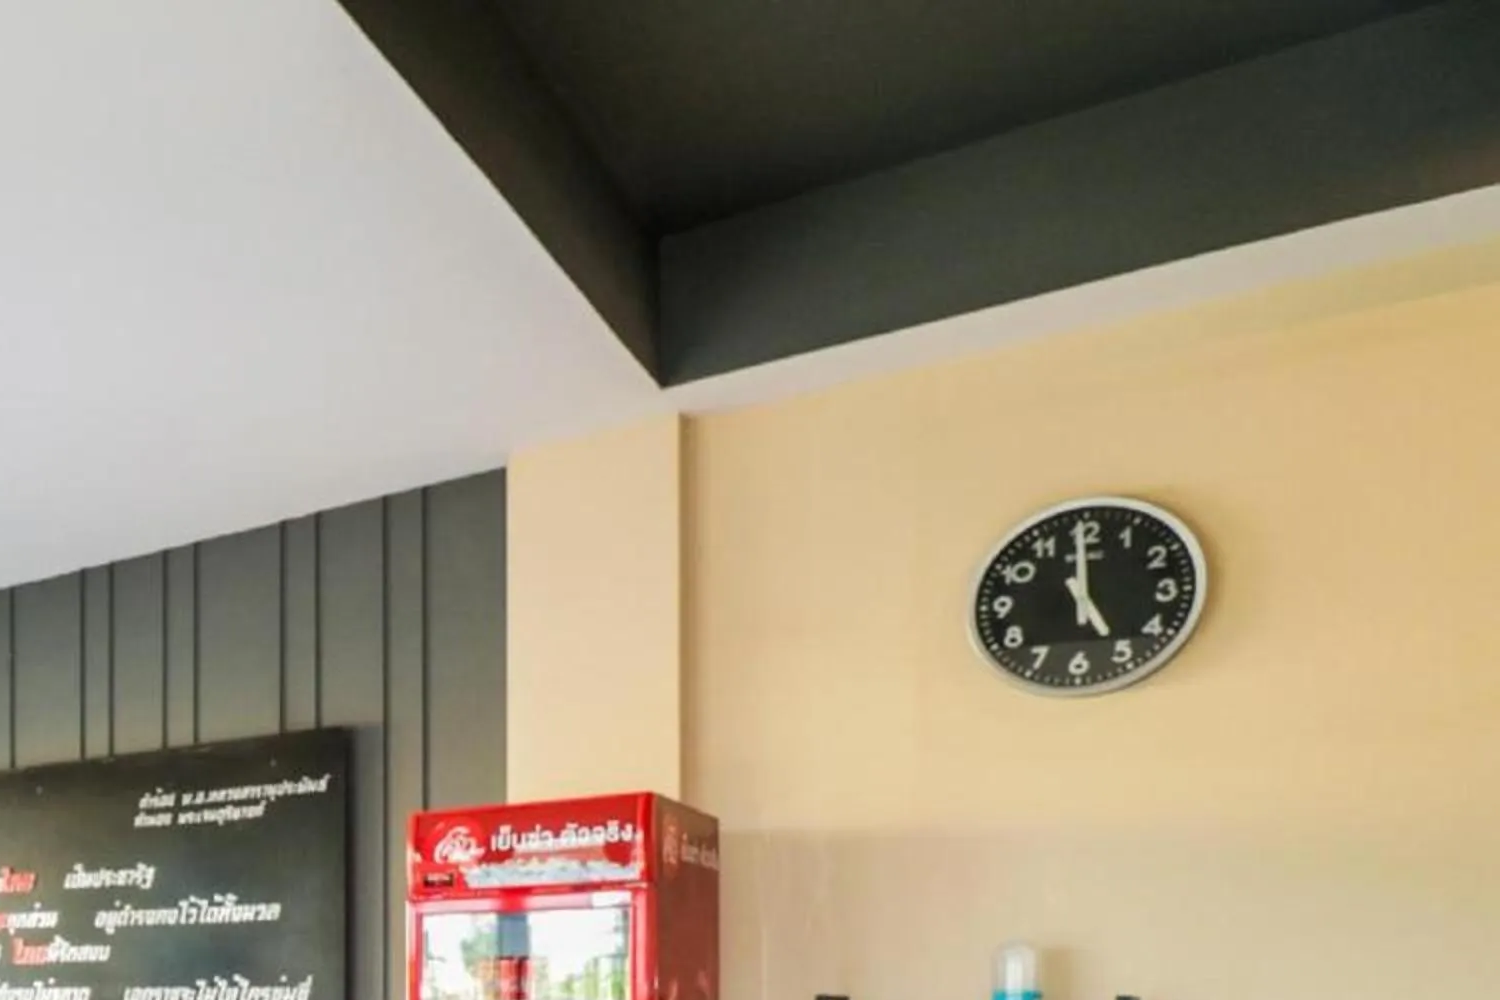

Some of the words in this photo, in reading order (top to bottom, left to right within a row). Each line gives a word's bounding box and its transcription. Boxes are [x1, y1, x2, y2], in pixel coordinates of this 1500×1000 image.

[1032, 537, 1056, 558] 11
[1118, 526, 1132, 549] 1
[1147, 545, 1167, 569] 2
[1002, 561, 1036, 584] 10
[1155, 578, 1178, 602] 3
[992, 595, 1013, 618] 9
[1003, 625, 1023, 648] 8
[1141, 614, 1163, 636] 4
[1030, 645, 1050, 669] 7
[1111, 639, 1132, 663] 5
[1068, 652, 1089, 675] 6
